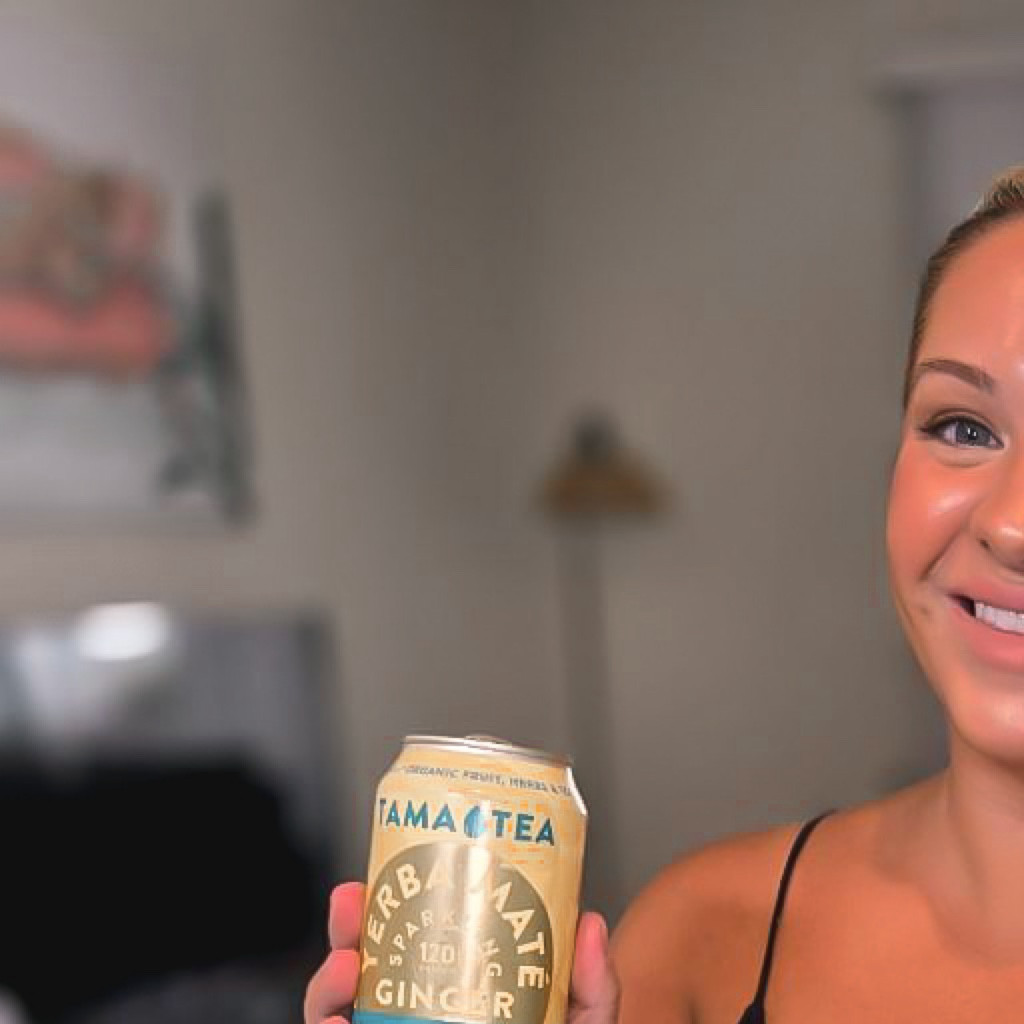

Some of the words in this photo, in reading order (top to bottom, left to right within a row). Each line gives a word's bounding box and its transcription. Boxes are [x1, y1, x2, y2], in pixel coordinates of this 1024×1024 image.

[379, 797, 457, 832] TAMA
[491, 809, 555, 847] TEA
[361, 857, 455, 972] YERBA
[389, 909, 503, 977] SPARKNG
